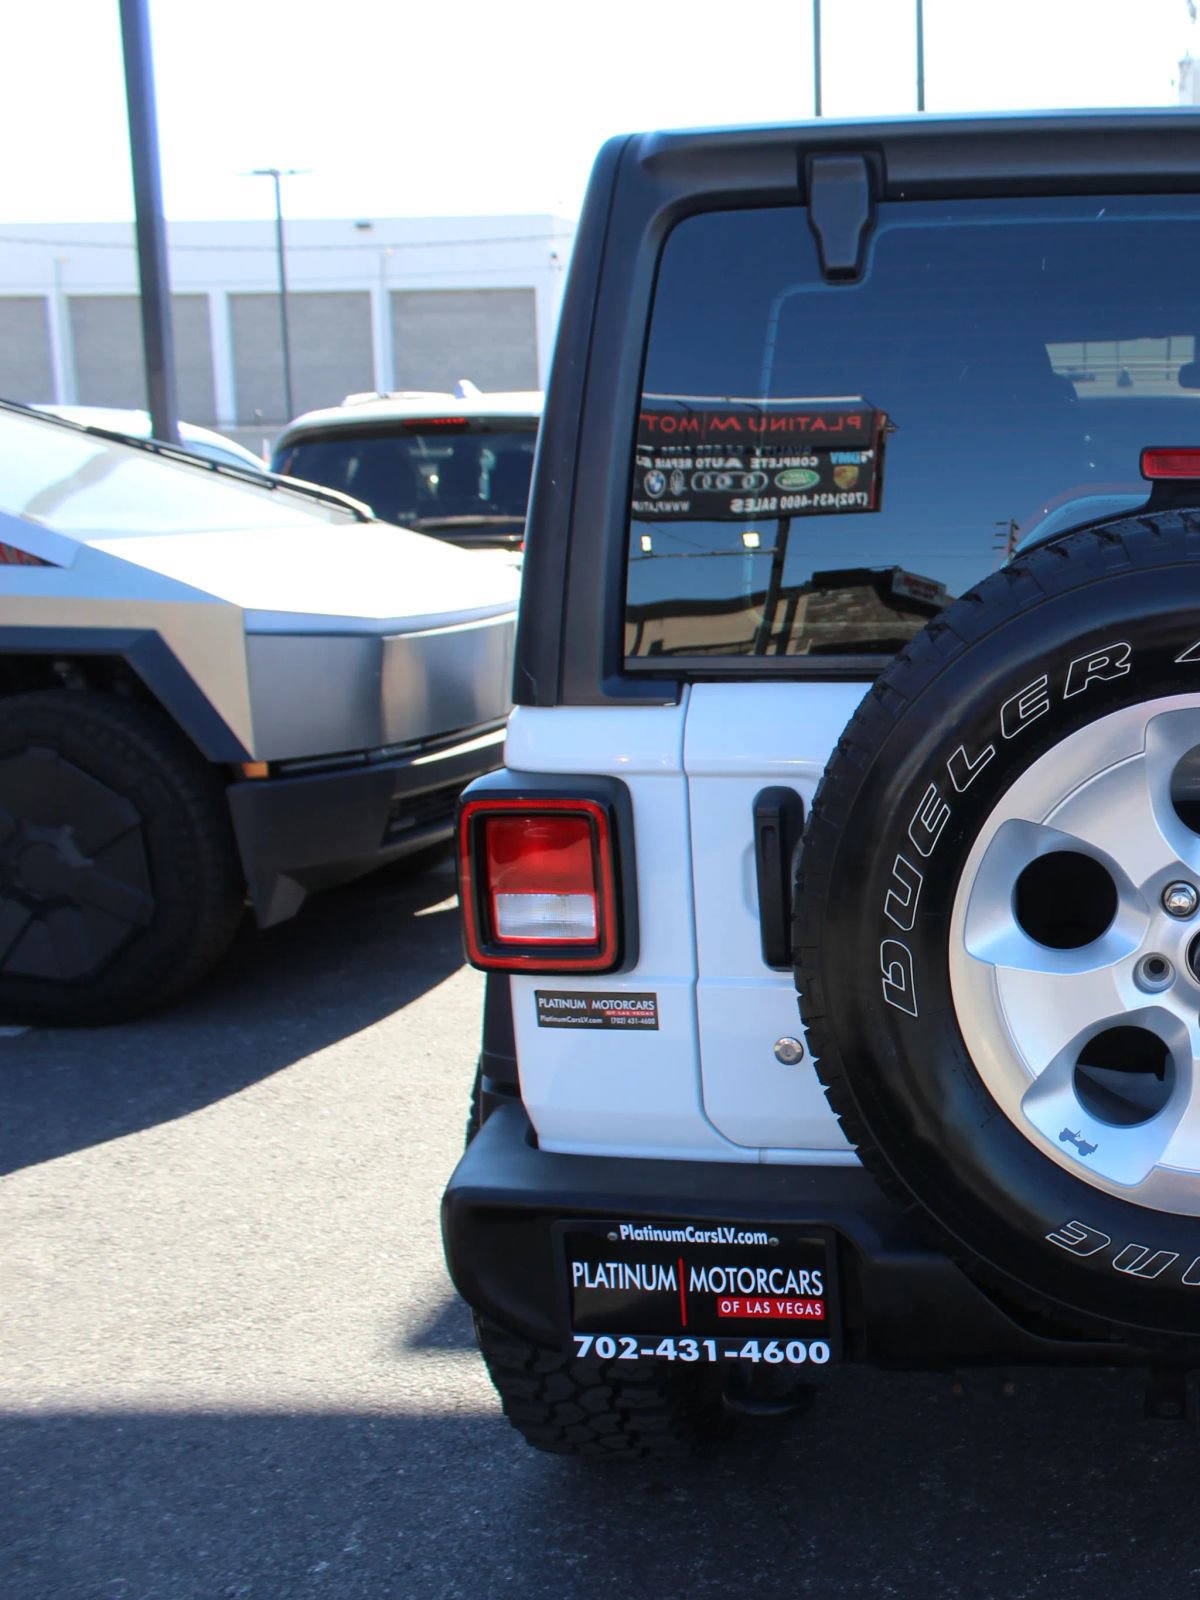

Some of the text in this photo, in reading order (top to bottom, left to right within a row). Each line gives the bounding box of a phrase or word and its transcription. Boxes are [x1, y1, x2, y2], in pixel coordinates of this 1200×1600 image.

[879, 641, 1132, 1018] DUELER
[538, 997, 655, 1010] PLATINUM MOTORCARS
[540, 1015, 603, 1024] PlatinumCarsLV.com
[619, 1223, 768, 1245] PlatinumCarsLV.com
[572, 1261, 824, 1296] PLATINUM MOTORCARS
[721, 1300, 822, 1316] OF LAS VEGAS
[573, 1335, 831, 1364] 702-431-4600
